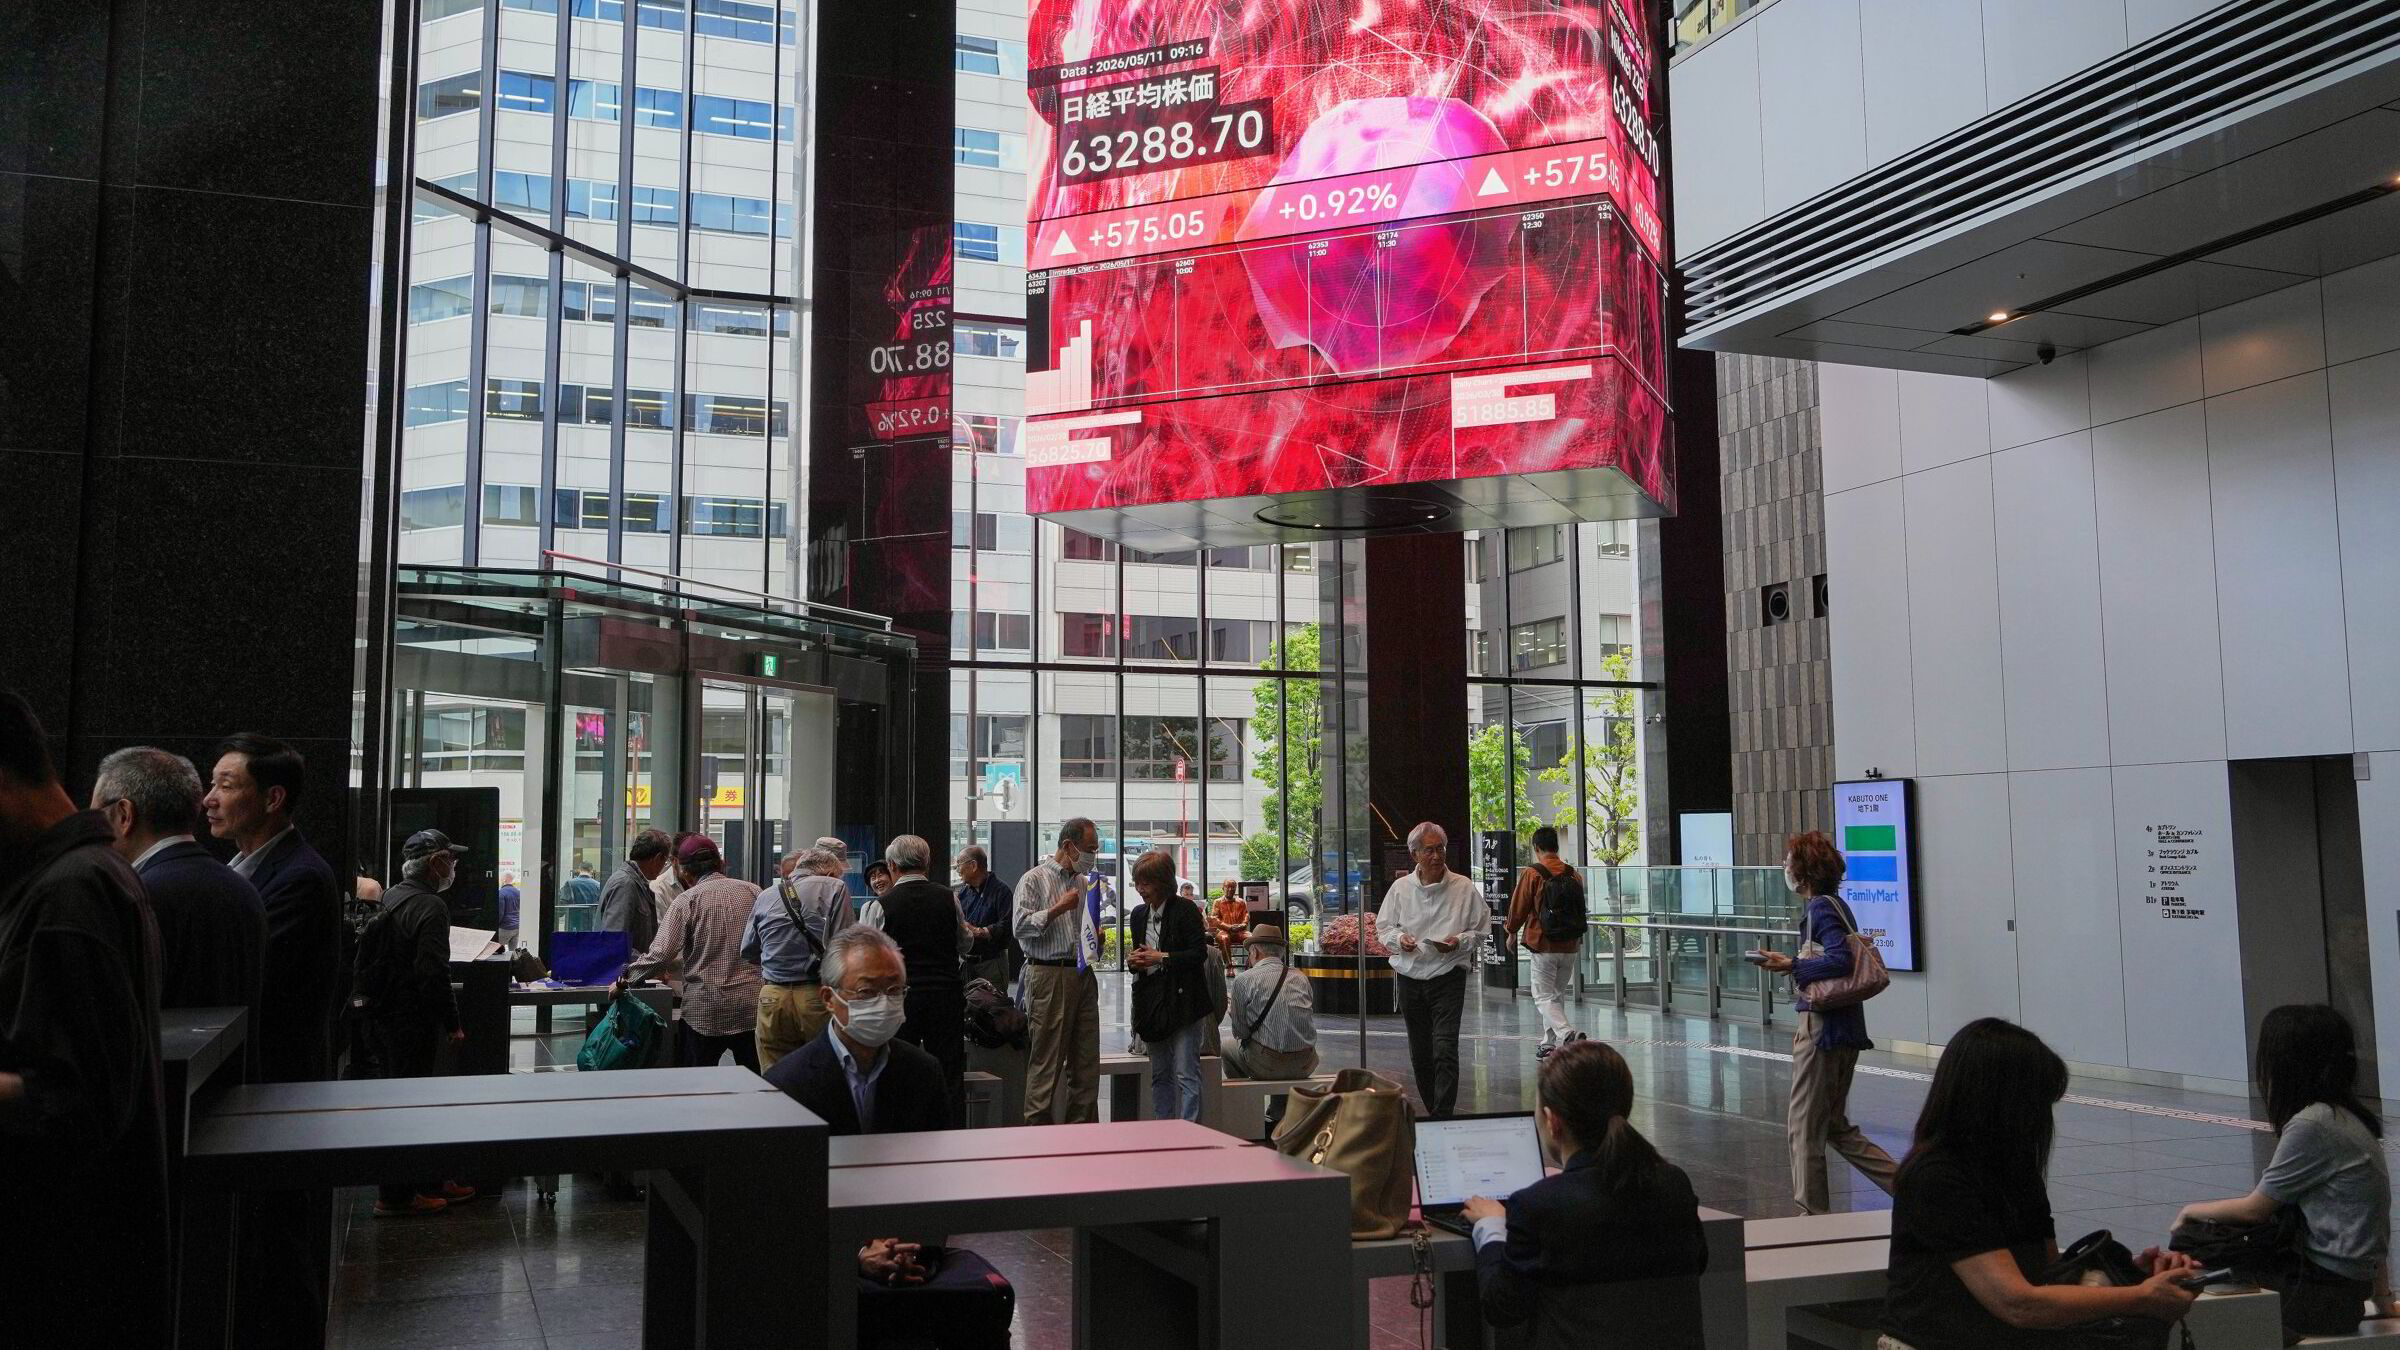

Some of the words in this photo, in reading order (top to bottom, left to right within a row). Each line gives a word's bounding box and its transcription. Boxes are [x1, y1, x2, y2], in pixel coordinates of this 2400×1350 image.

[1060, 67, 1087, 79] Data
[1096, 51, 1163, 72] 2026/05/11
[1170, 44, 1203, 60] 09:16
[1063, 73, 1215, 124] 日経平均株価
[1613, 75, 1659, 177] 63288.70
[1062, 110, 1264, 176] 63288.70
[1089, 210, 1204, 248] +575.05
[1279, 182, 1397, 221] +0.92%
[1523, 221, 1542, 229] 12:30
[1377, 232, 1399, 240] 62174
[1378, 240, 1397, 248] 11:30
[1309, 249, 1327, 257] 11:00
[1176, 267, 1193, 275] 10:00
[1028, 287, 1045, 295] 09:00
[1456, 399, 1550, 425] 51885.85
[1028, 442, 1105, 463] 56825.70
[1848, 795, 1873, 803] KABUTO
[1875, 794, 1888, 802] ONE
[1847, 888, 1899, 903] FamilyMart
